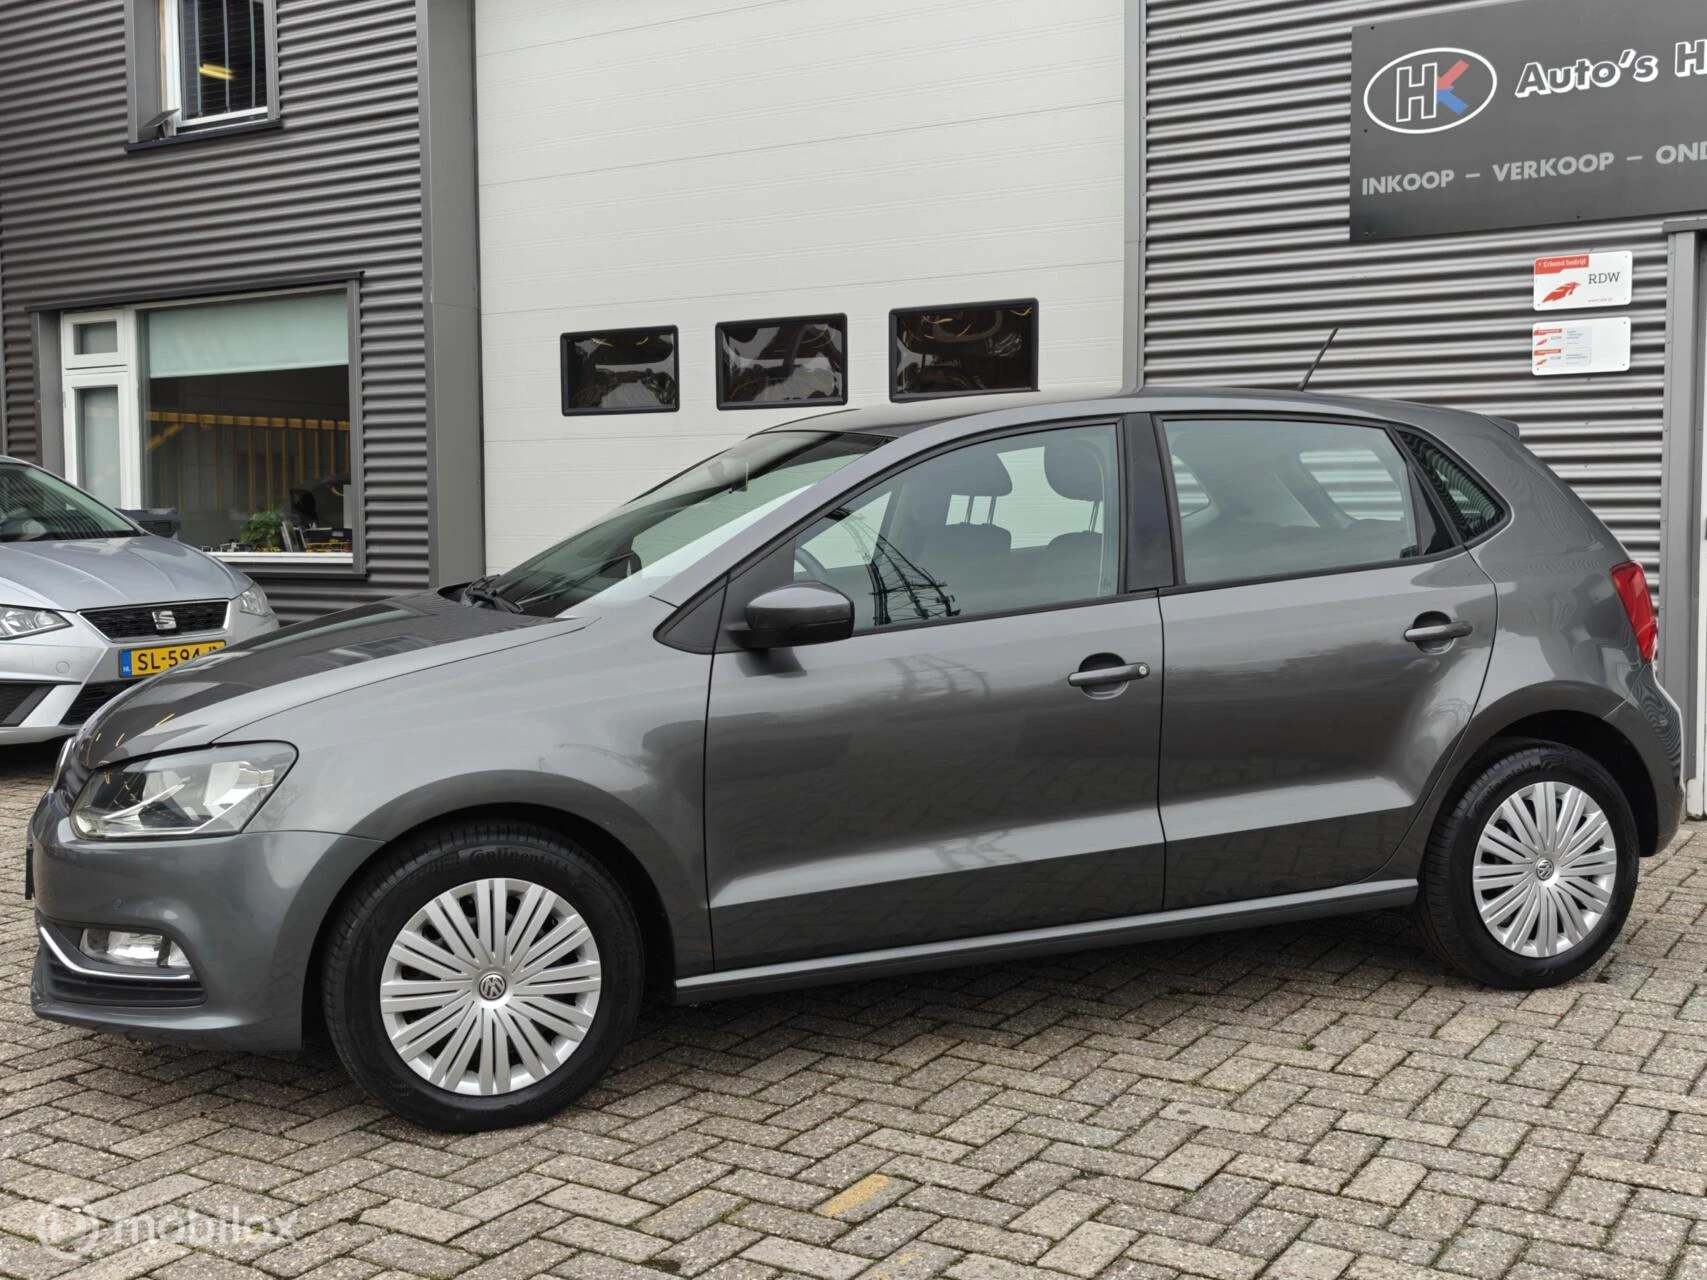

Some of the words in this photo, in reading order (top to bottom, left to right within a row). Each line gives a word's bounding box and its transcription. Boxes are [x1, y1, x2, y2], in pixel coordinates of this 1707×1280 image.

[1515, 49, 1658, 98] Auto's
[1362, 169, 1455, 196] INKOOP
[1492, 152, 1615, 182] VERKOOP
[1588, 271, 1621, 285] RDW
